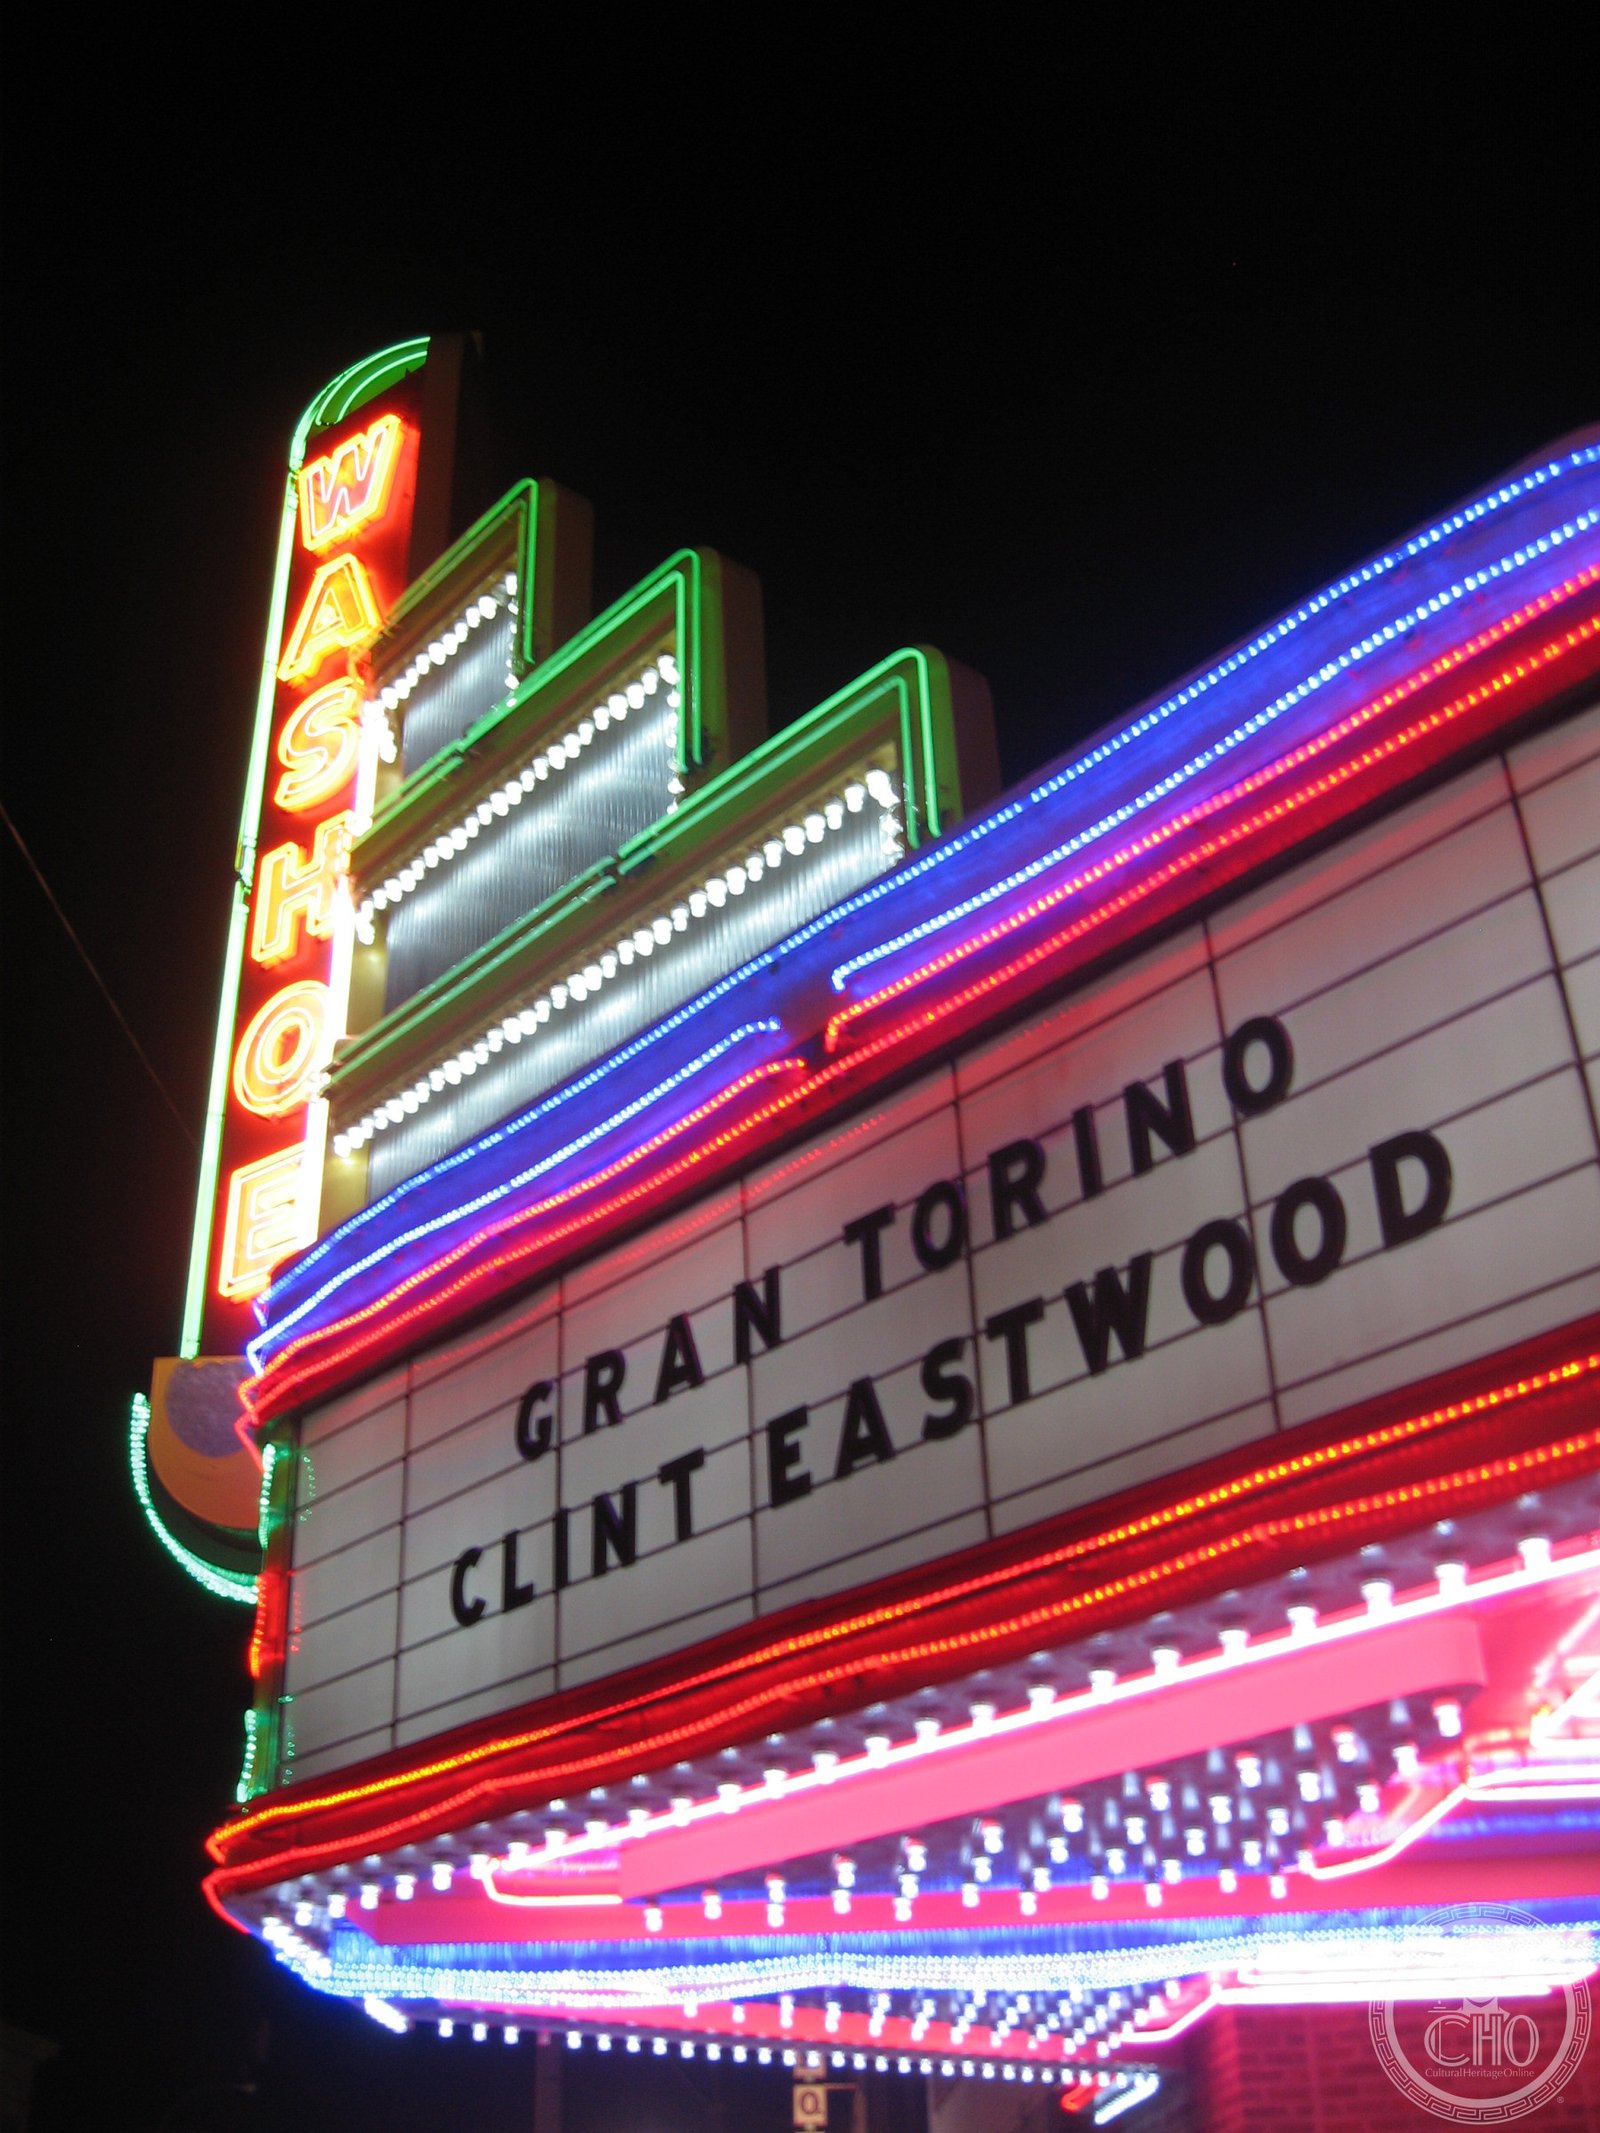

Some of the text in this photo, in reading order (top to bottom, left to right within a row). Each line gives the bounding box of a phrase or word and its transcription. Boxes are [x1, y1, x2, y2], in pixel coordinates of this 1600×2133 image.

[217, 413, 403, 1302] WASHOE
[450, 1129, 1453, 1629] CLINT EASTWOOD
[515, 1014, 1296, 1463] GRAN TORINO
